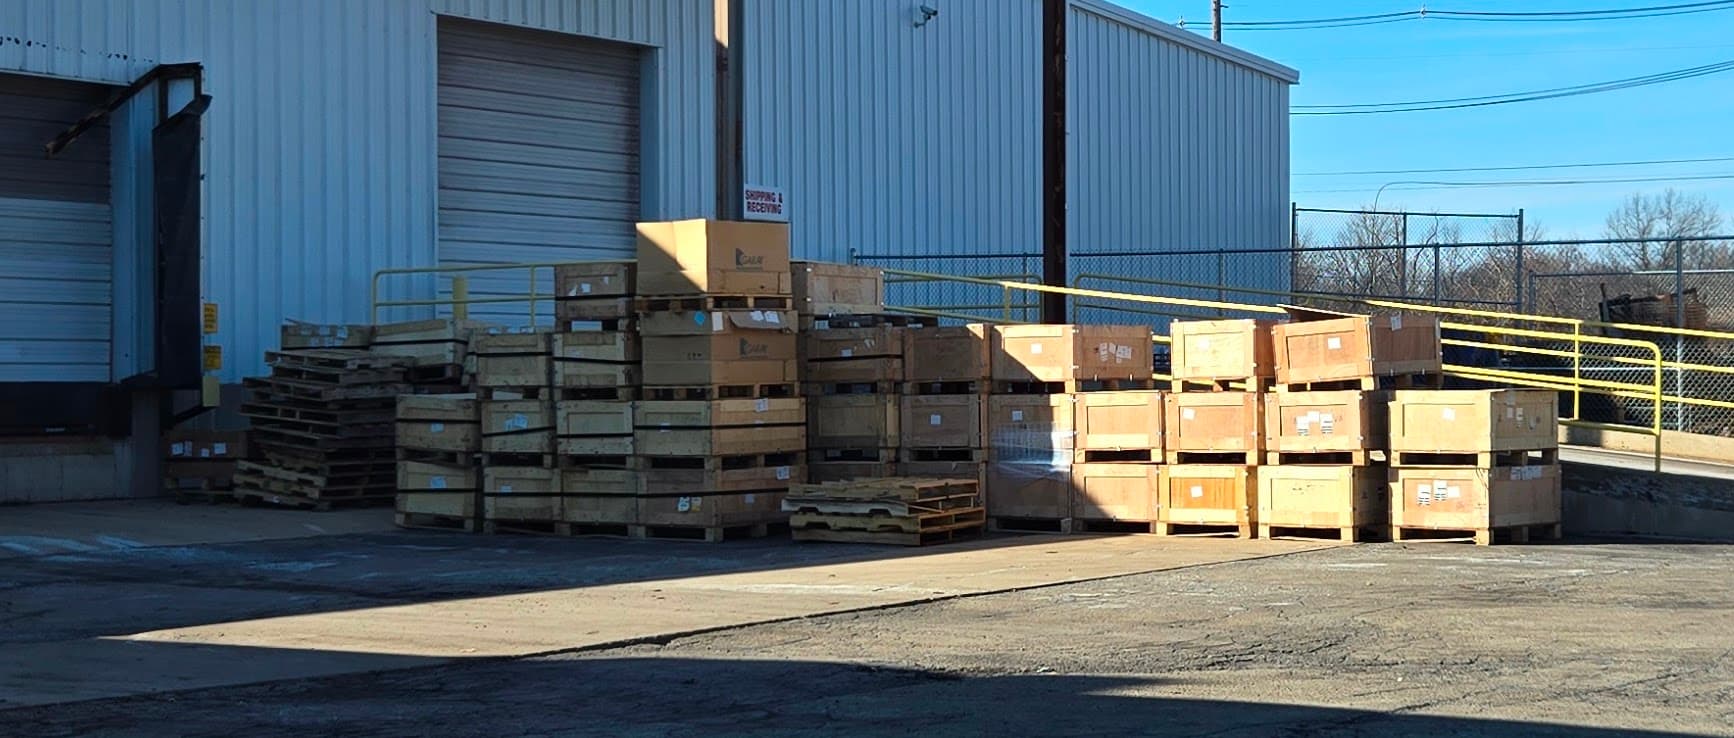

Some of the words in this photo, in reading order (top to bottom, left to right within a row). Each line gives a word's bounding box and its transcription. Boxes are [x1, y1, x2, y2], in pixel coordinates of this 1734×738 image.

[745, 190, 776, 202] SHIPPING
[778, 192, 783, 203] &
[747, 201, 782, 214] RECEIVING
